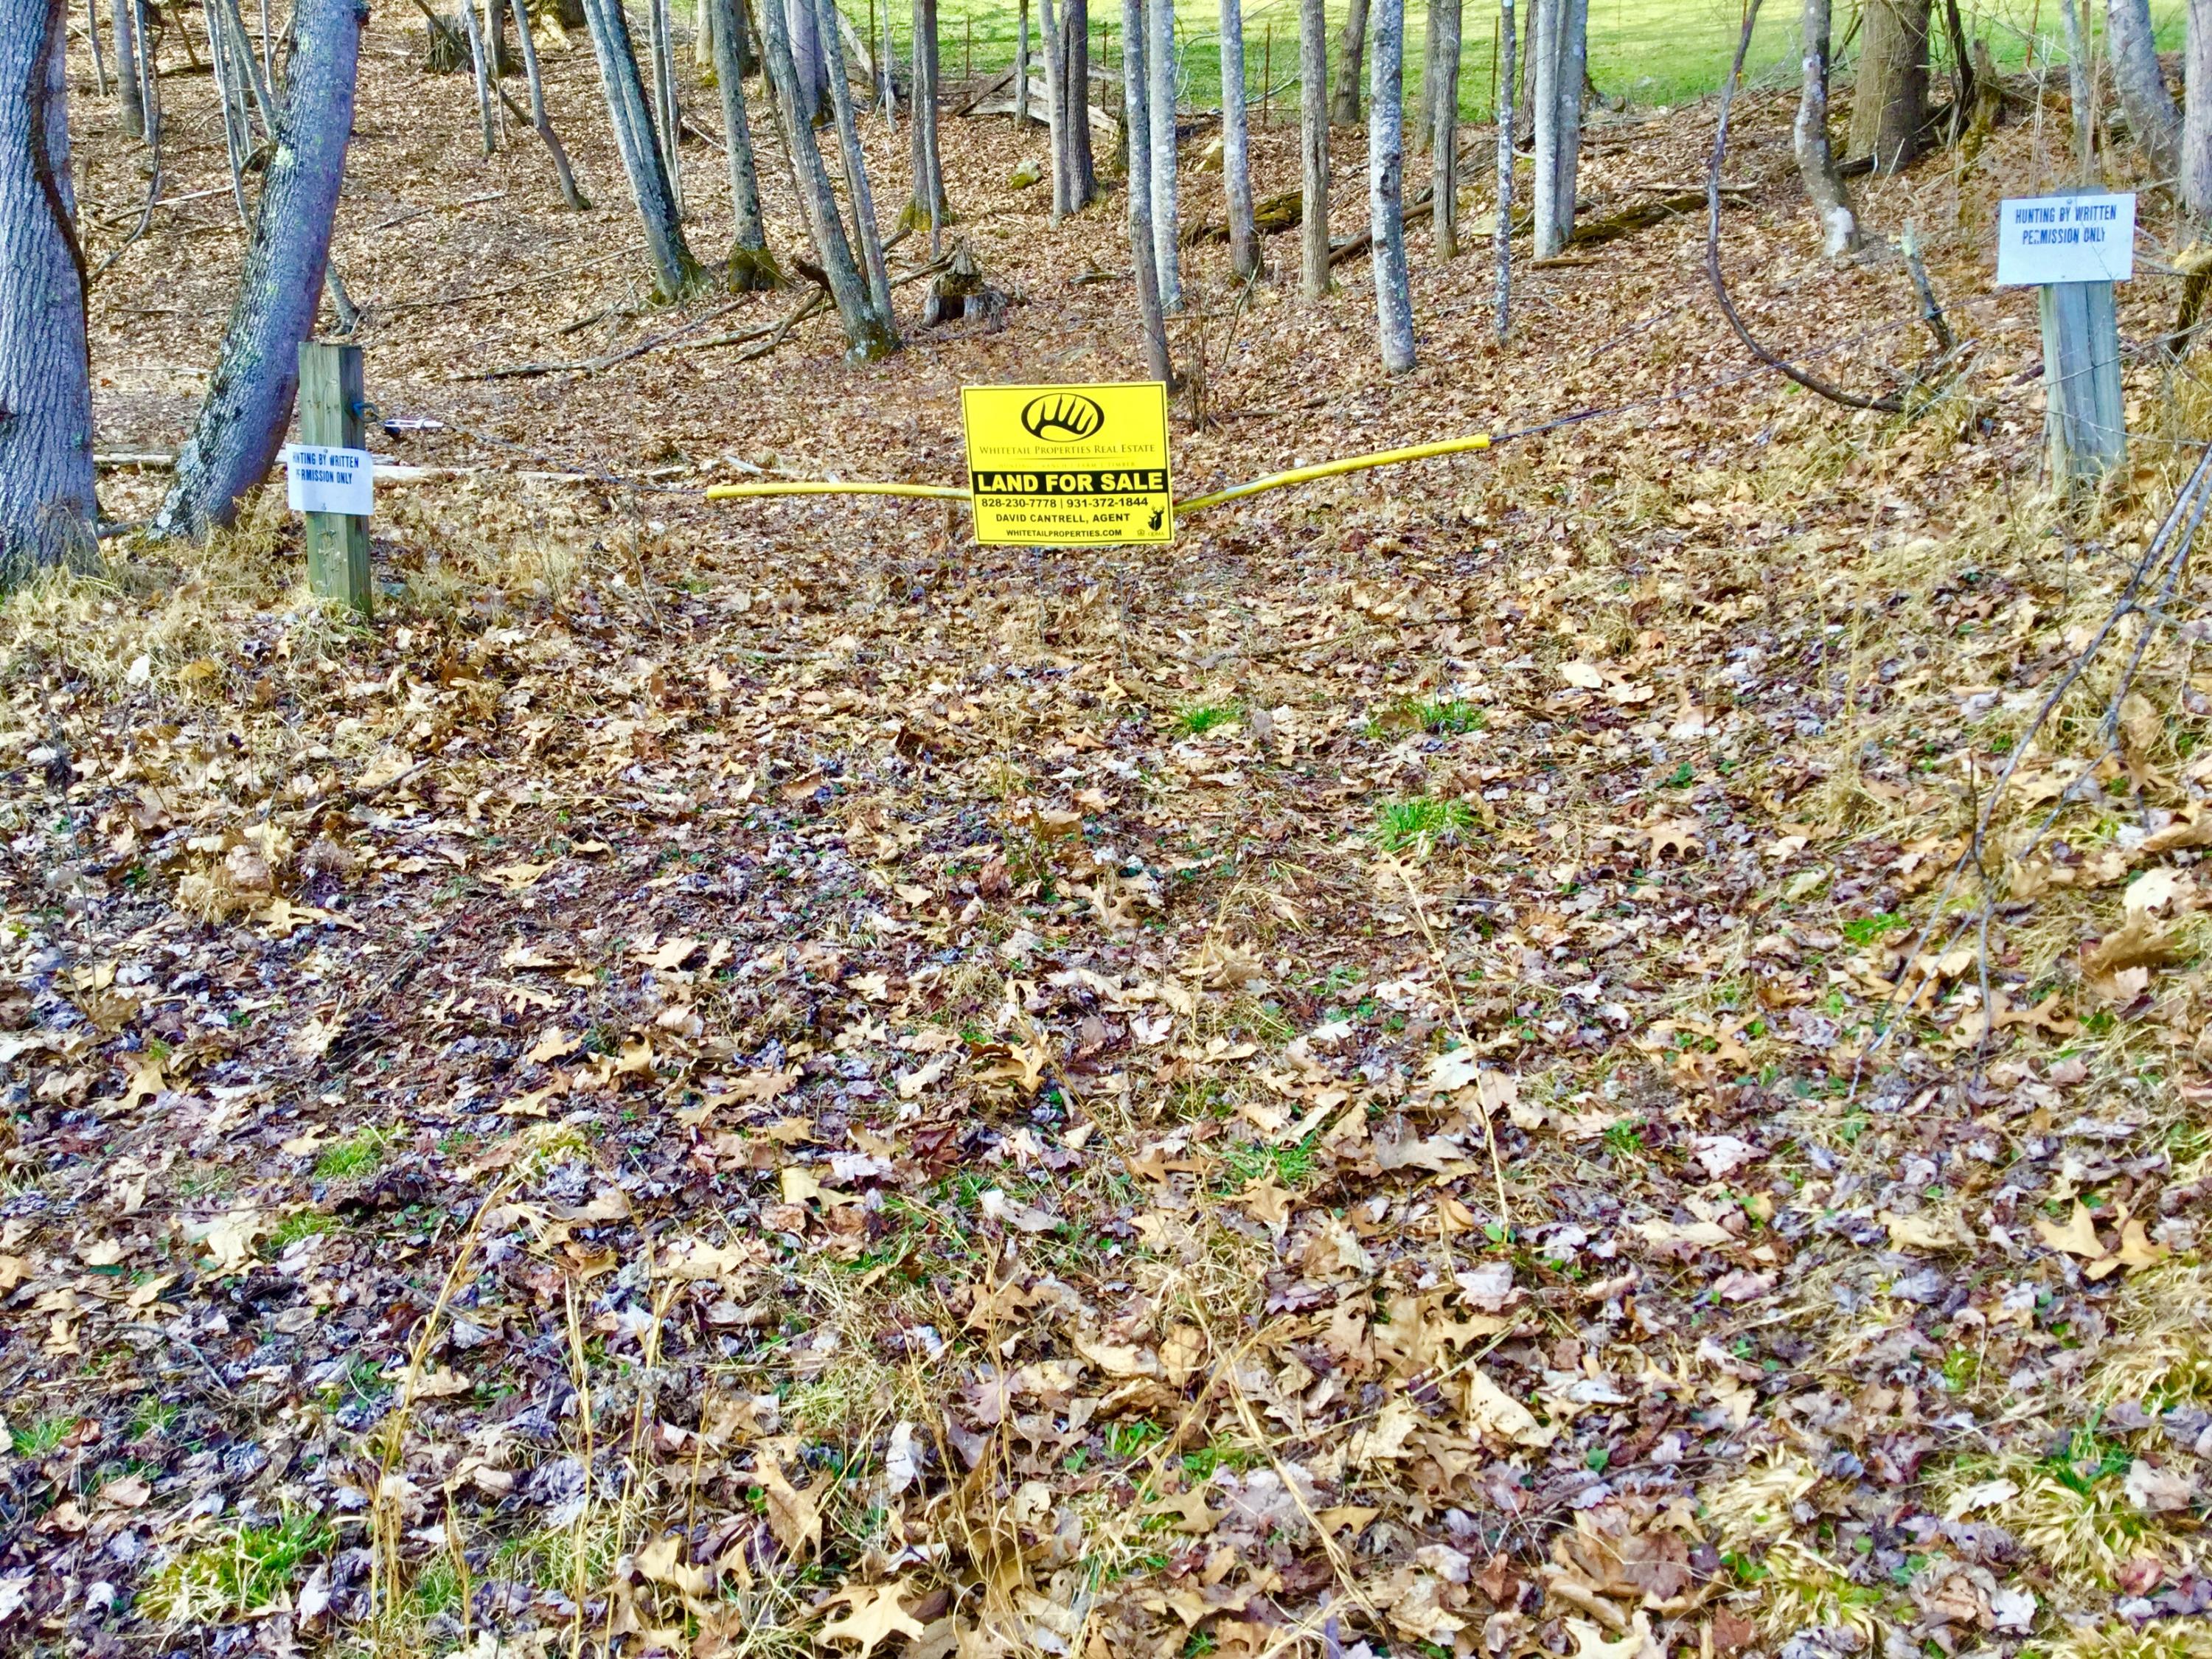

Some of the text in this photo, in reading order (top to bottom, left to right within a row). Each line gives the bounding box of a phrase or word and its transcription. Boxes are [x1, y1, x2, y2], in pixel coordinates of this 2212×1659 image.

[2016, 205, 2116, 223] HUNTING BY WRITTEN
[293, 452, 359, 468] TING BY WRITTEN
[336, 472, 352, 484] ONLY
[978, 472, 1164, 493] LAND FOR SALE
[981, 498, 1057, 508] 828-230-7778
[1066, 497, 1149, 508] 931-372-1844
[996, 513, 1130, 524] DAVID CANTRELL, AGENT
[1006, 529, 1122, 538] WHITETAILPROPERTIES.COM
